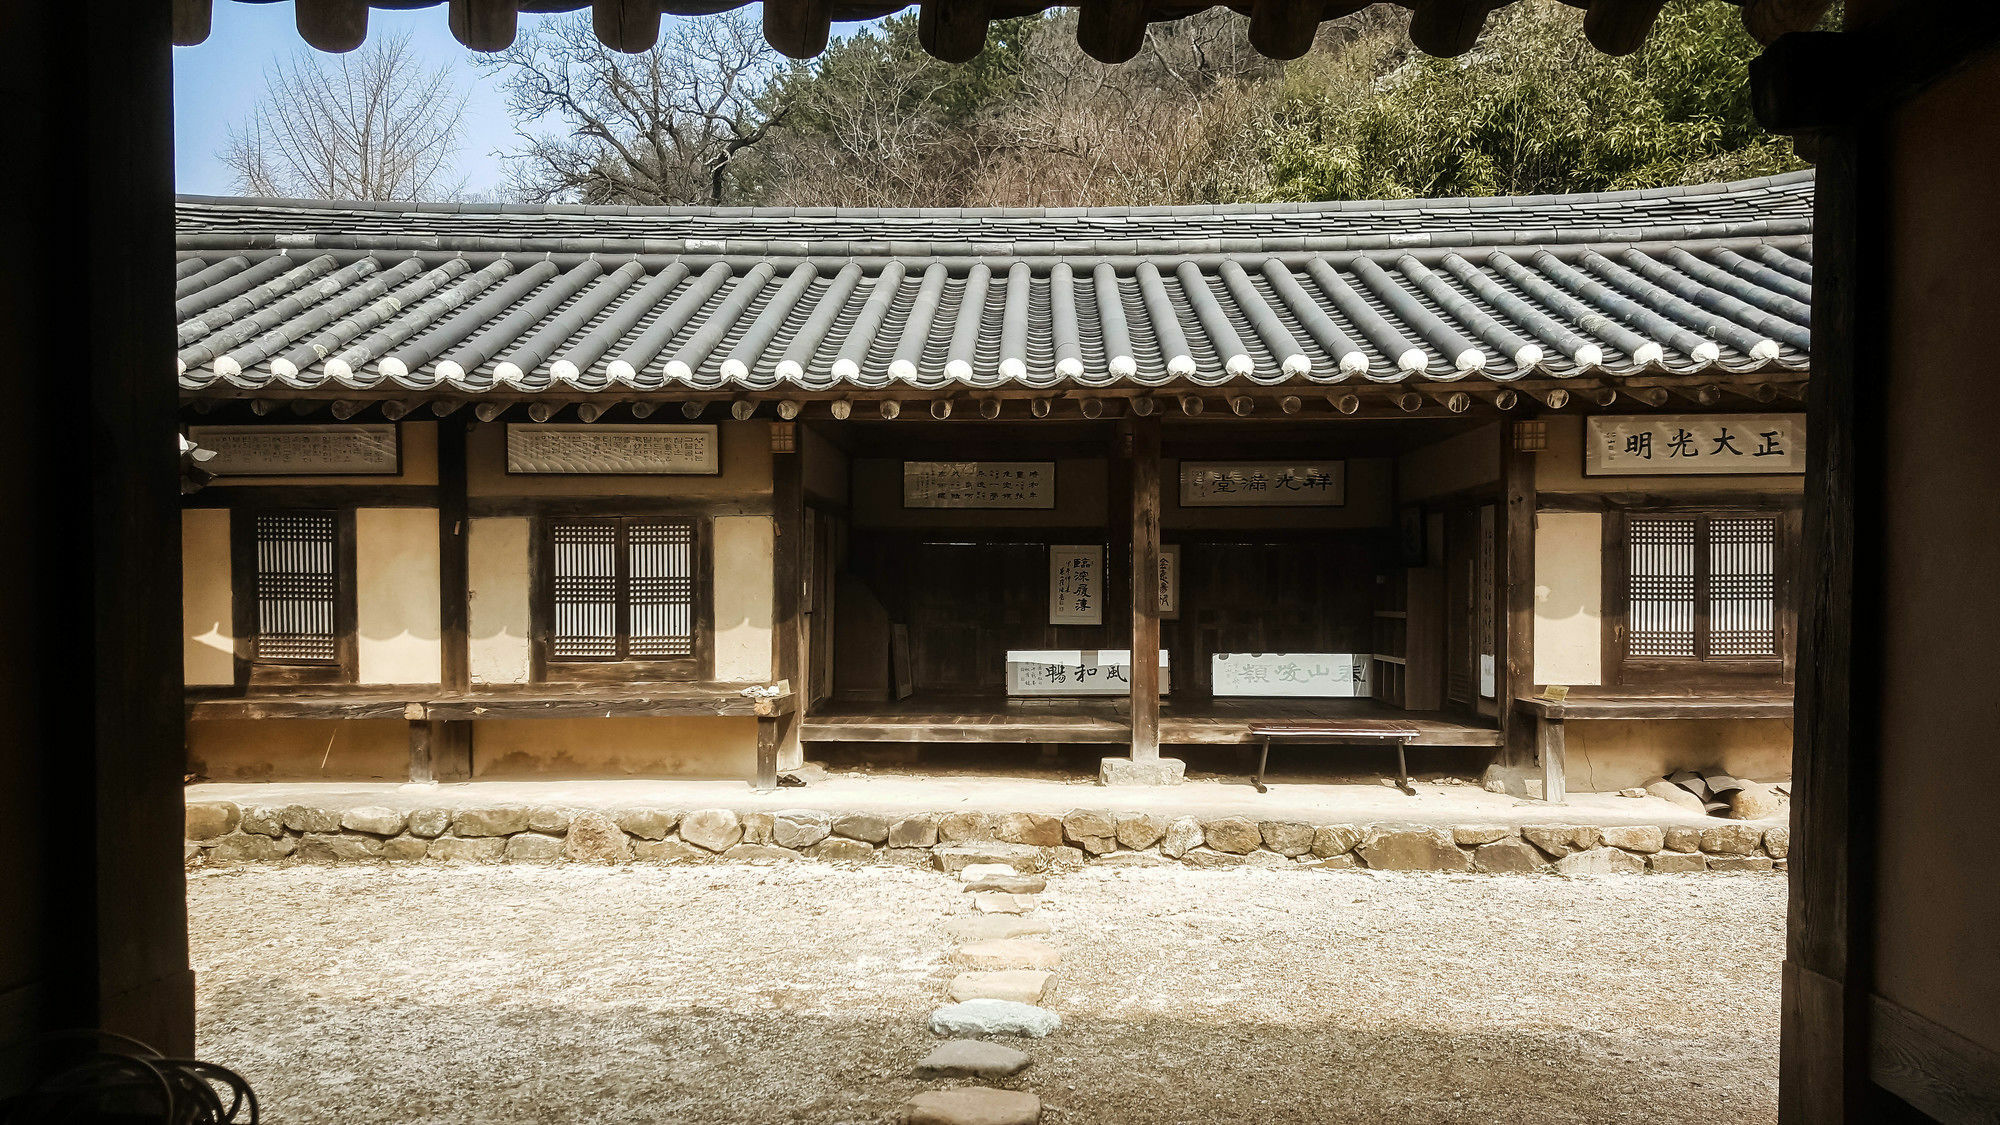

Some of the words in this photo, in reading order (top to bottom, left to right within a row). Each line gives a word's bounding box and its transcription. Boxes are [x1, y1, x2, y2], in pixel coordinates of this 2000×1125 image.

[1623, 427, 1785, 460] 正大光明
[1073, 558, 1091, 611] 臨深履薄
[1045, 663, 1128, 683] 風和暢
